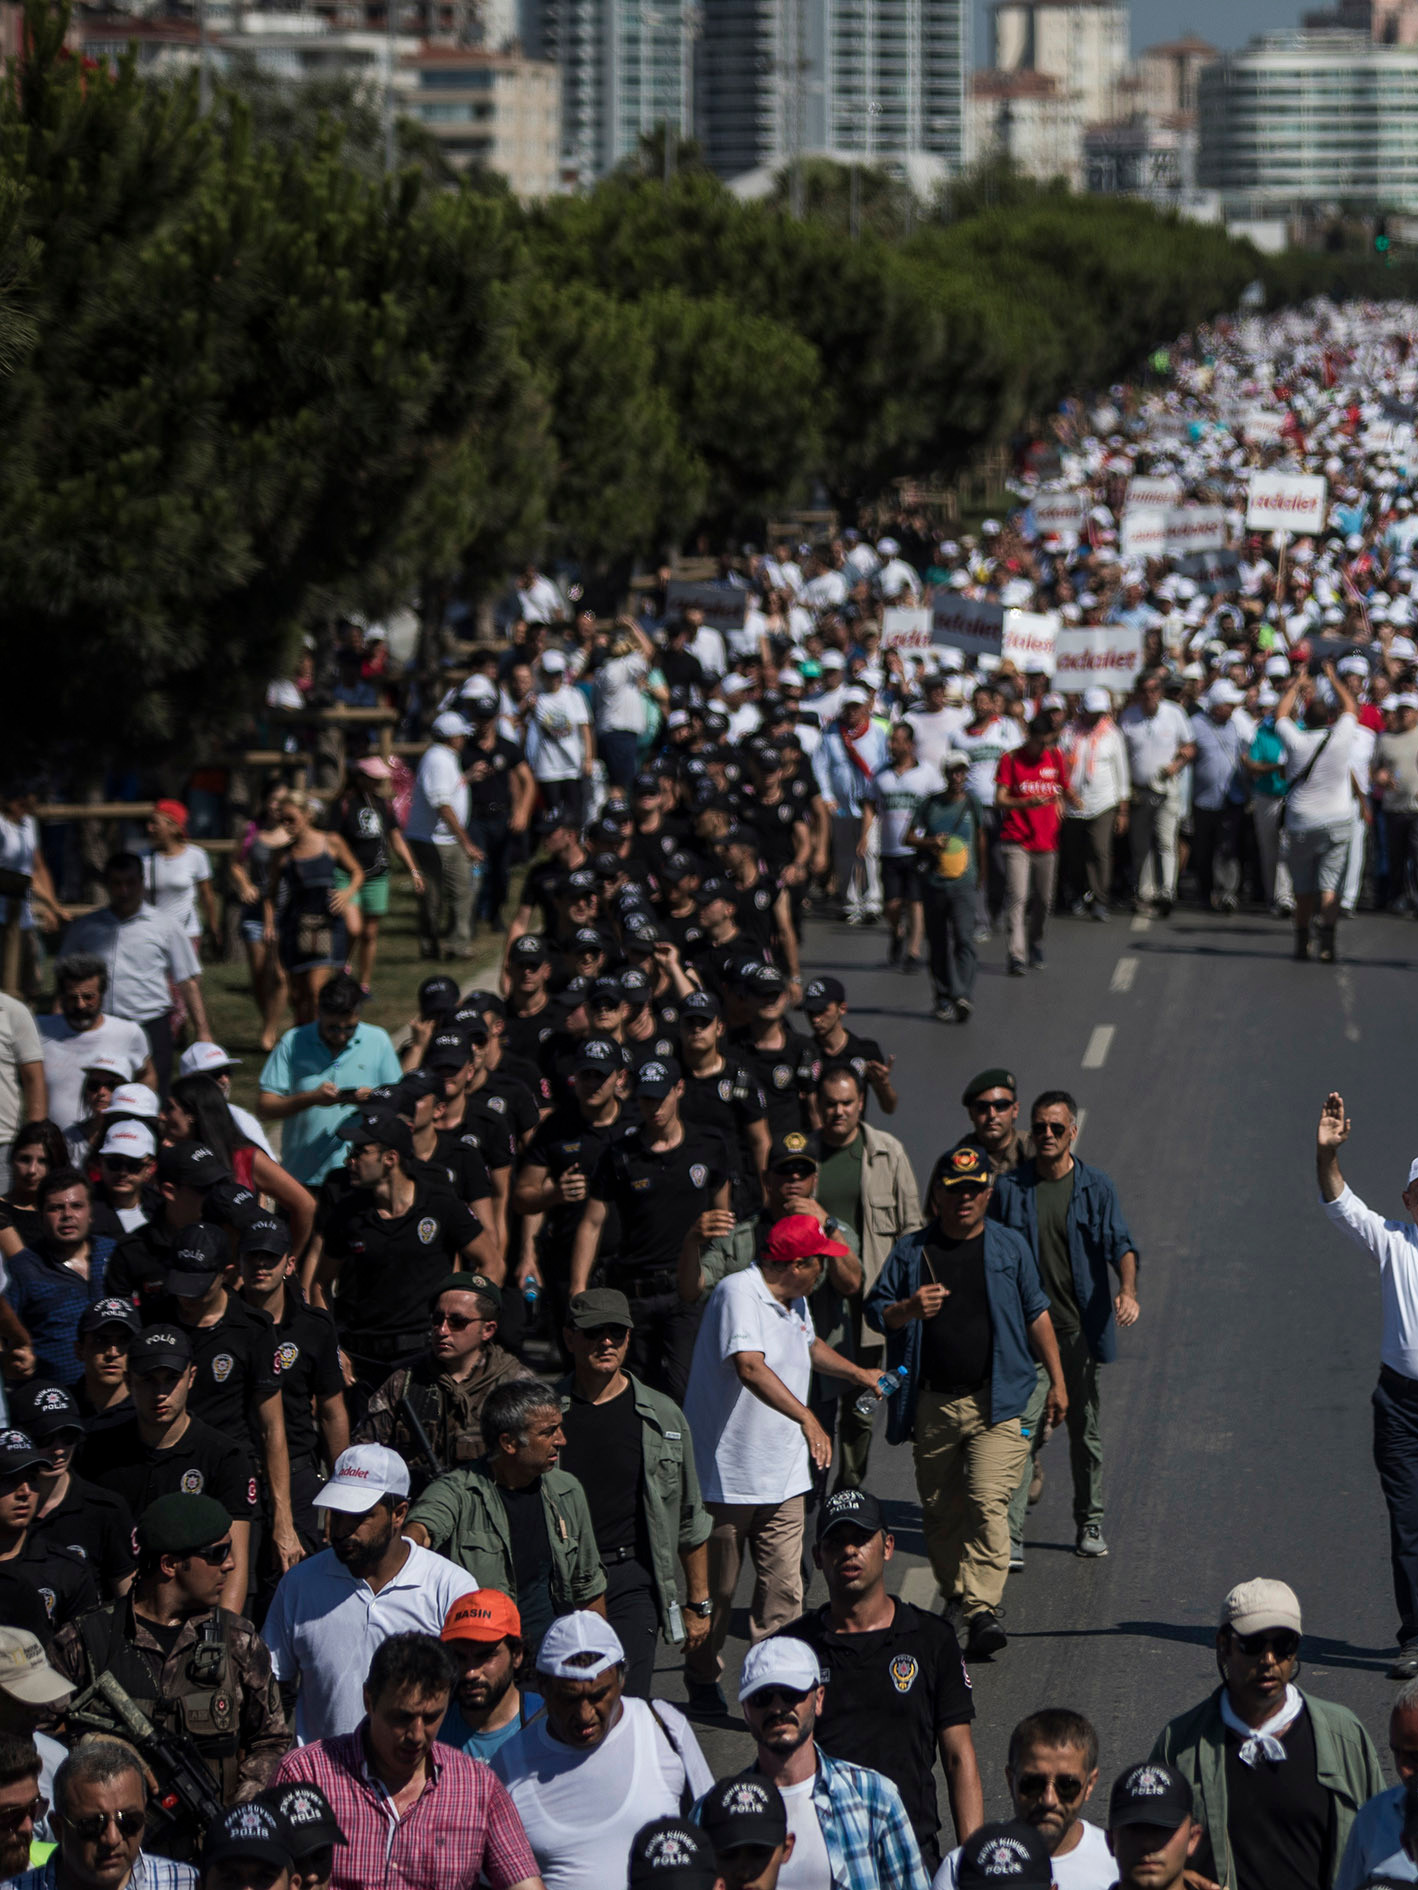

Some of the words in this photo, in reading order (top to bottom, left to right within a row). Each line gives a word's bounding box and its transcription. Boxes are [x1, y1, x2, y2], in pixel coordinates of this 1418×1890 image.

[1250, 490, 1318, 513] adalet
[1056, 649, 1138, 672] adalet
[339, 1466, 369, 1480] adalet
[454, 1608, 492, 1623] BASIN
